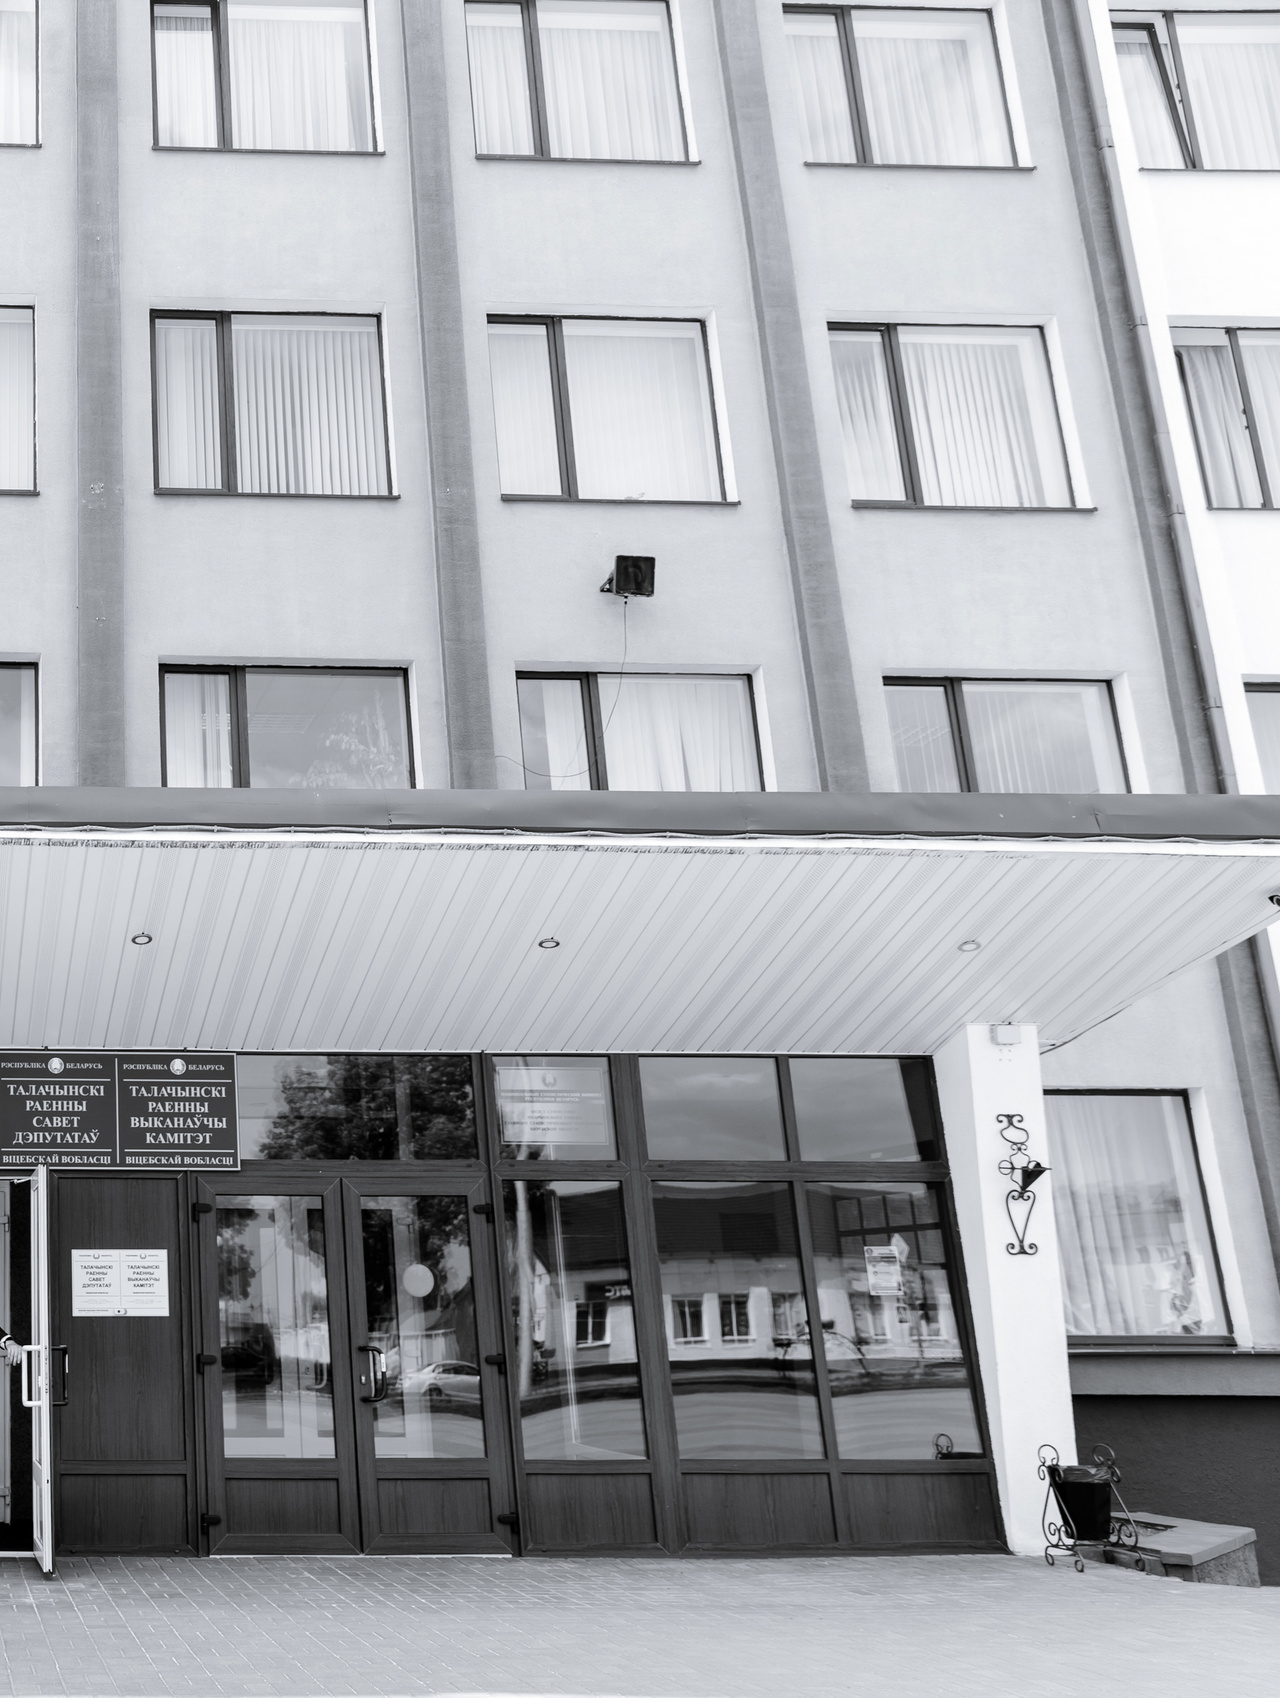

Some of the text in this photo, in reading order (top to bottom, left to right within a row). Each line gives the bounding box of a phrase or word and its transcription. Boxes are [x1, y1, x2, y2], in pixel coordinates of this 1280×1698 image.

[66, 1062, 103, 1070] БЕЛАРУСЬ
[7, 1084, 105, 1096] ТАЛАЧЫНСКІ
[129, 1085, 227, 1098] ТАЛАЧЫНСКІ
[25, 1100, 87, 1112] РАЕННЫ
[148, 1101, 209, 1113] РАЕННЫ
[32, 1116, 81, 1128] САВЕТ
[130, 1114, 228, 1129] ВЫКАНАЎЧЫ
[12, 1129, 100, 1145] ДЭПУТАТАЎ
[145, 1132, 213, 1144] КАМІТЭТ
[2, 1154, 111, 1165] ВІЦЕБСКАЙ ВОБЛАСЦІ
[125, 1155, 234, 1166] ВІЦЕБСКАЙ ВОБЛАСЦІ
